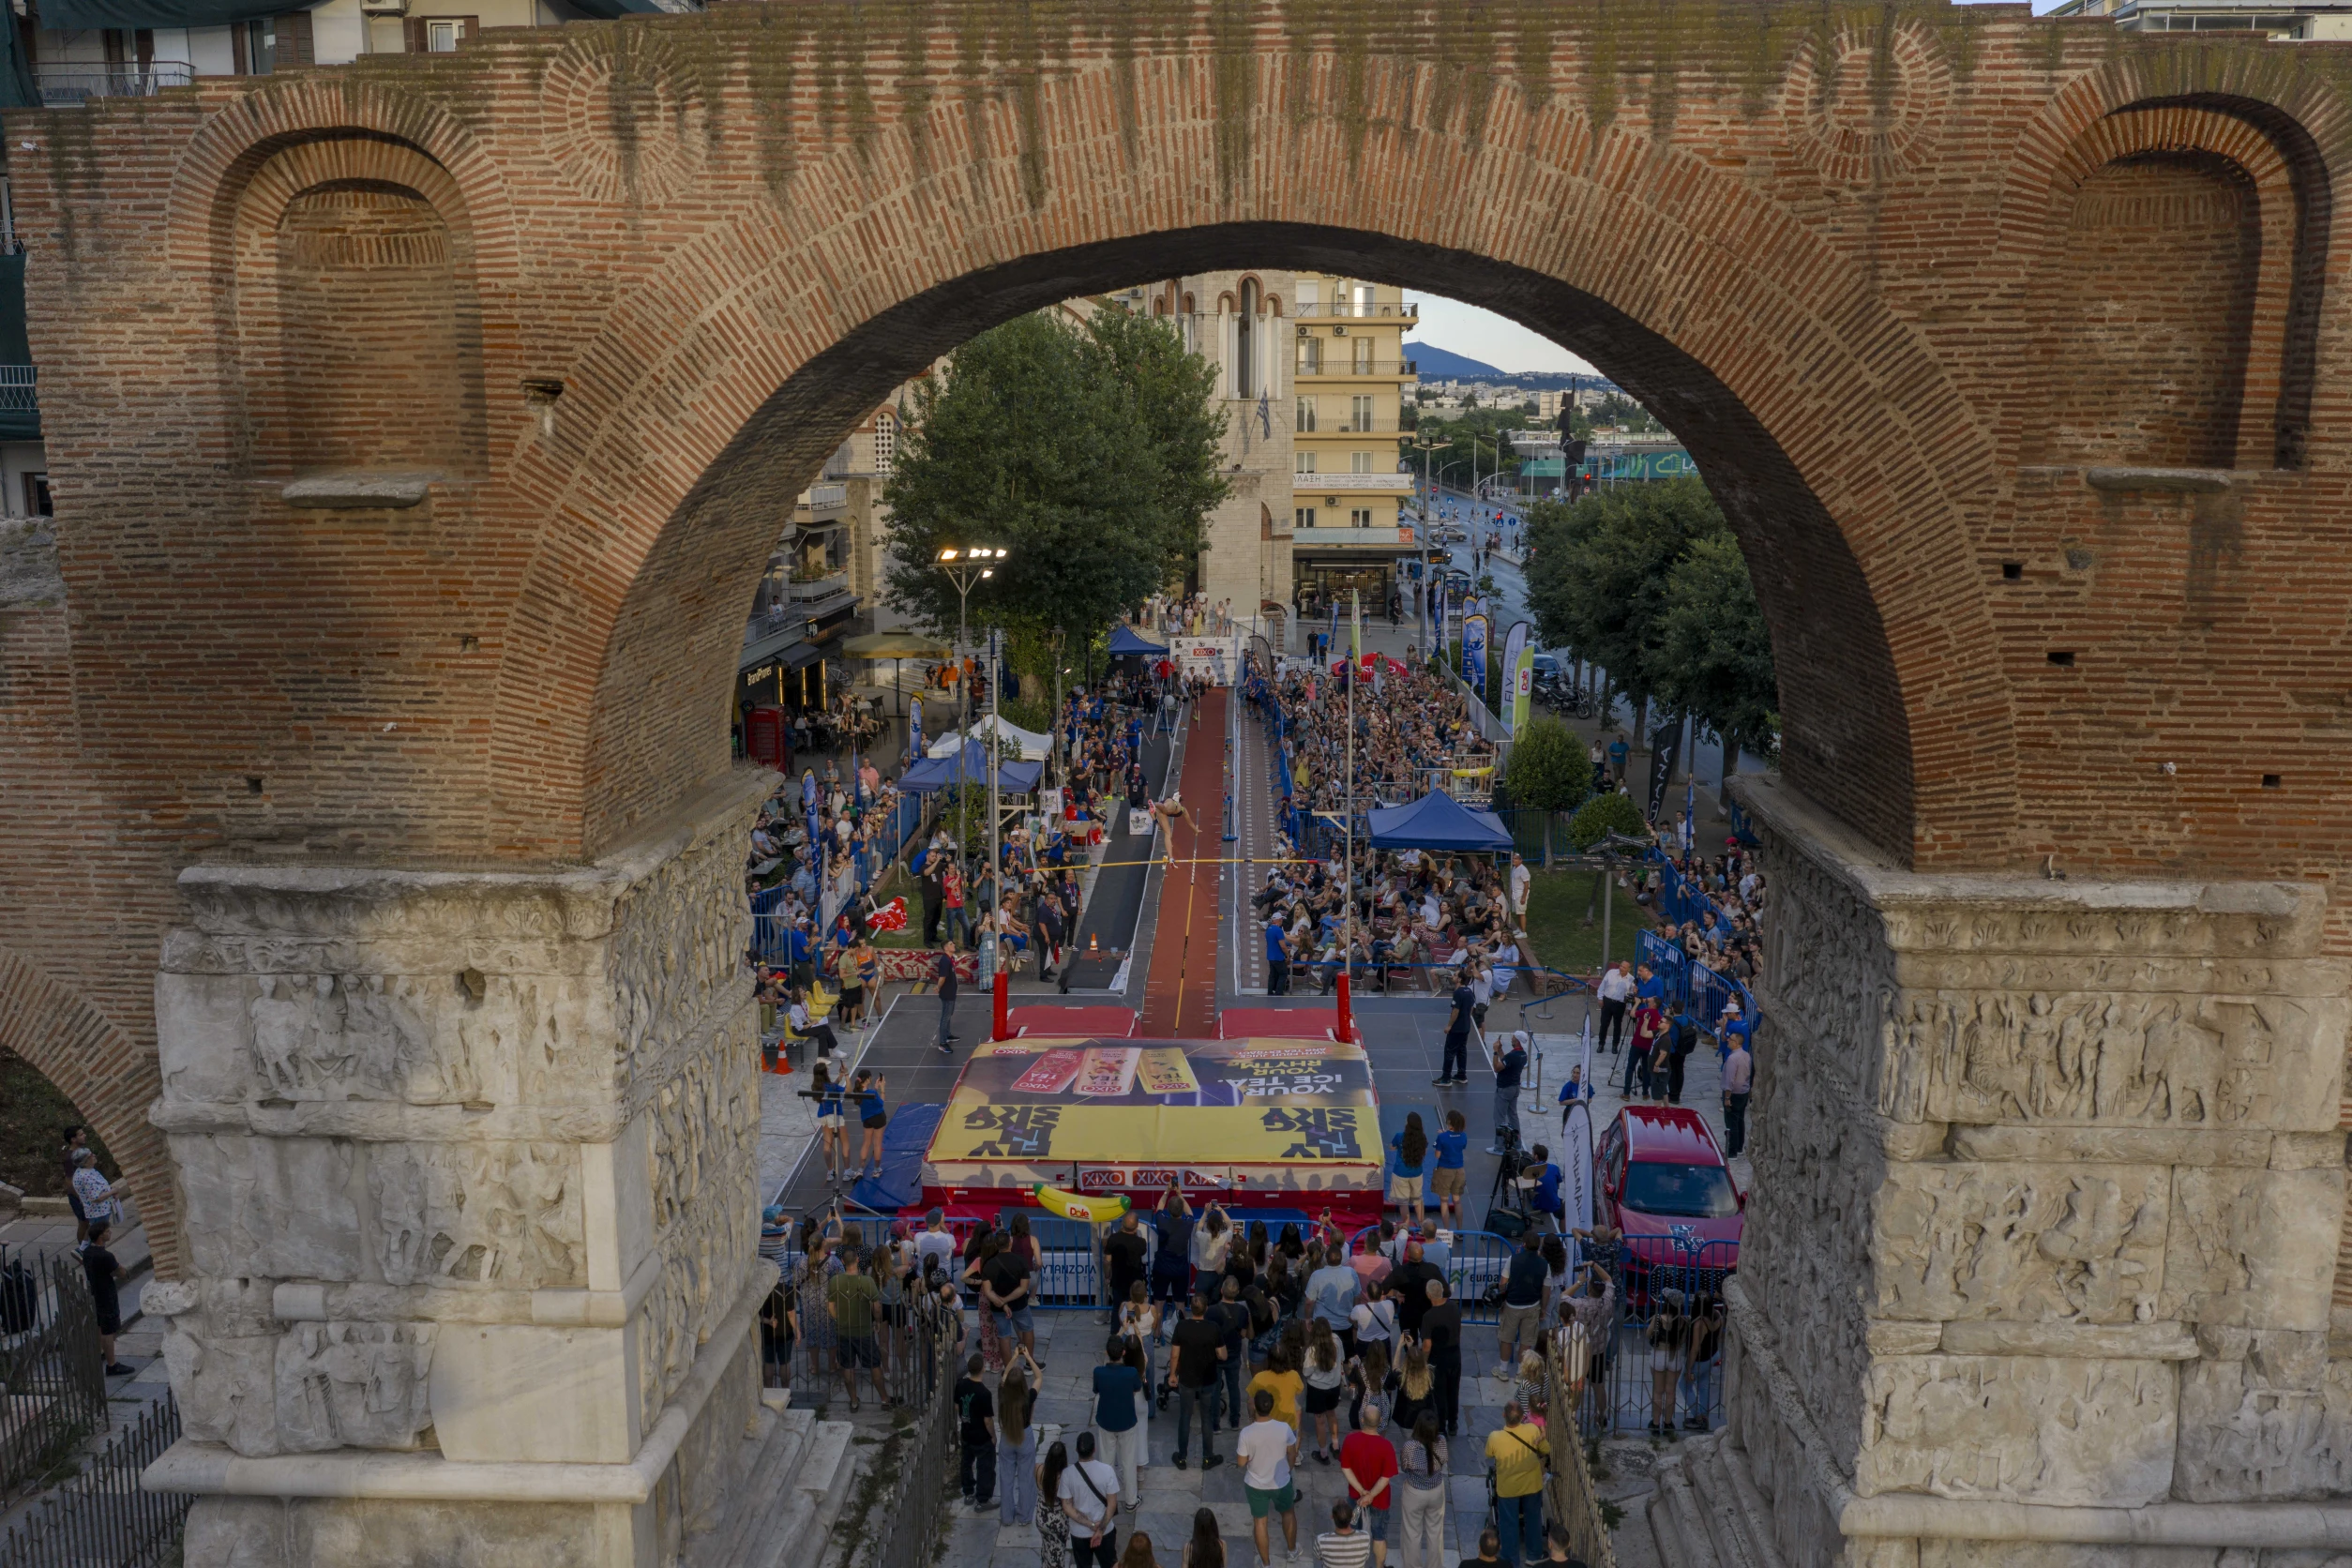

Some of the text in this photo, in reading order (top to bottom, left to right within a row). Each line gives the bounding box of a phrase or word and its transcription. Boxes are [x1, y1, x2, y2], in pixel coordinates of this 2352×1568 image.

[747, 665, 772, 686] BrandPhones
[1253, 1067, 1319, 1076] YOUR
[1019, 1081, 1051, 1090] XIXO
[1294, 1074, 1342, 1084] ICE
[1244, 1083, 1334, 1096] YOUR
[967, 1140, 1052, 1156] FLY
[1280, 1143, 1362, 1158] FLY
[1085, 1171, 1123, 1185] XIXO
[1137, 1171, 1176, 1185] XIXO
[1070, 1206, 1090, 1219] Dole
